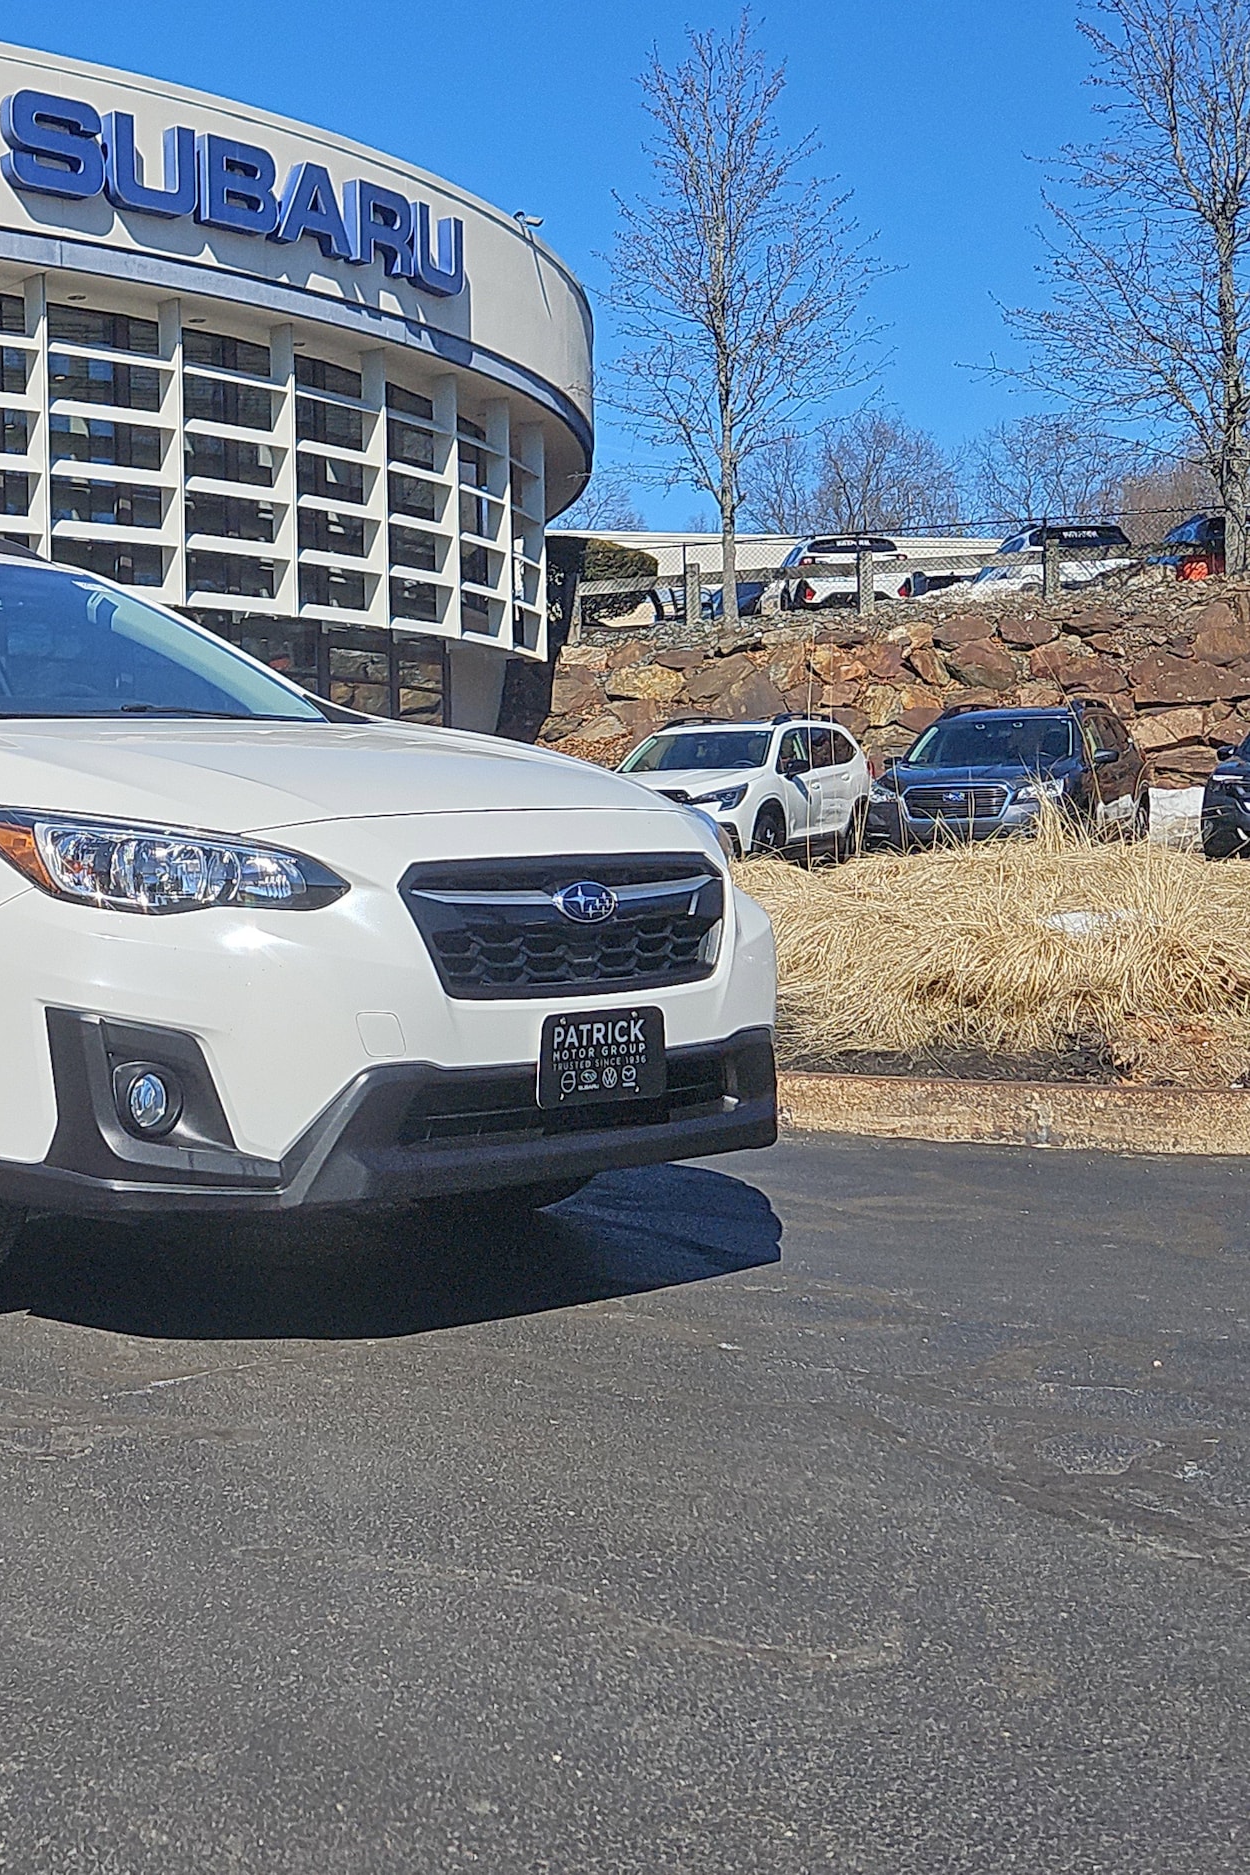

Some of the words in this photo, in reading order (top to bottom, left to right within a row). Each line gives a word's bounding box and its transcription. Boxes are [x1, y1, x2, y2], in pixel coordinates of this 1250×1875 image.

[0, 87, 465, 298] SUBARU
[554, 1019, 645, 1049] PATRICK
[553, 1047, 594, 1061] MOTOR
[602, 1043, 646, 1056] GROUP
[553, 1060, 591, 1071] TRUSTED
[595, 1056, 621, 1068] SINCE
